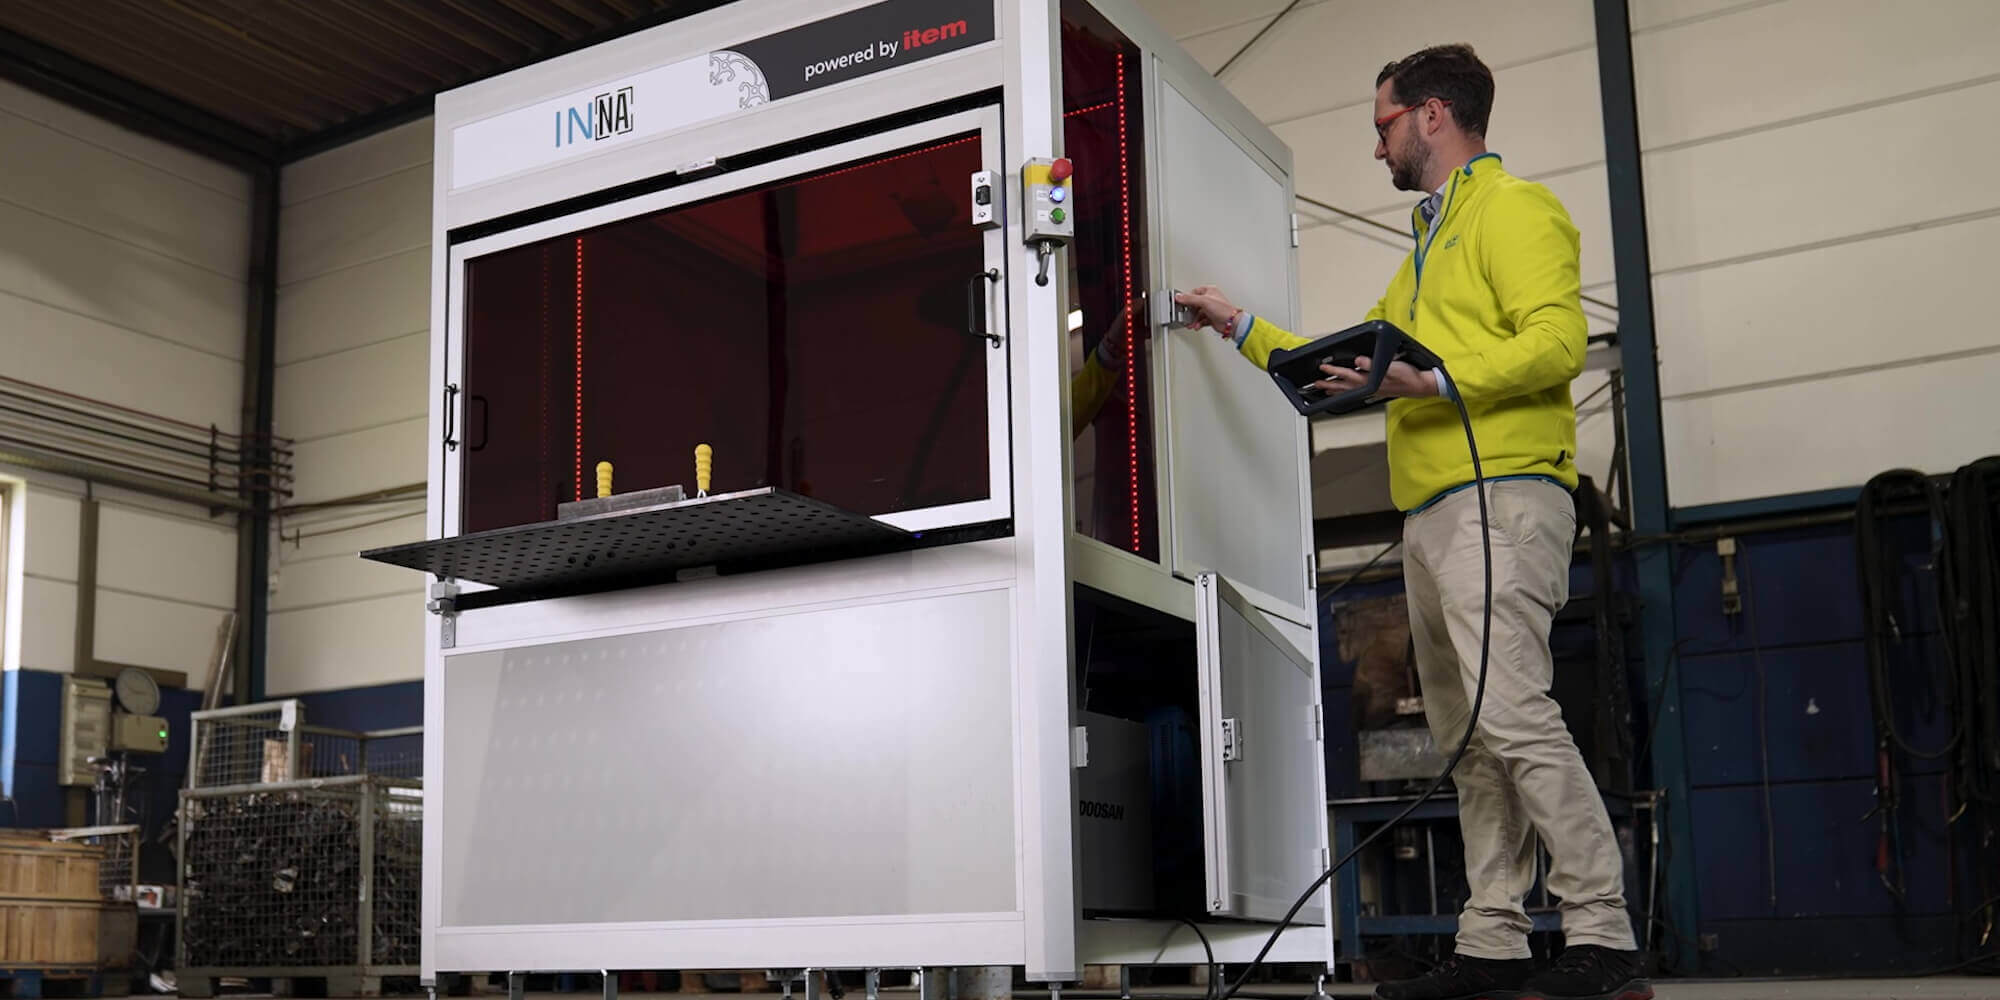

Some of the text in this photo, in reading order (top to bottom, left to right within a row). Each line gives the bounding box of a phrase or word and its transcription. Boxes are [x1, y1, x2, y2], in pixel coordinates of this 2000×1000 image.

[805, 20, 967, 81] powered by item
[1079, 800, 1124, 820] DOOSAN
